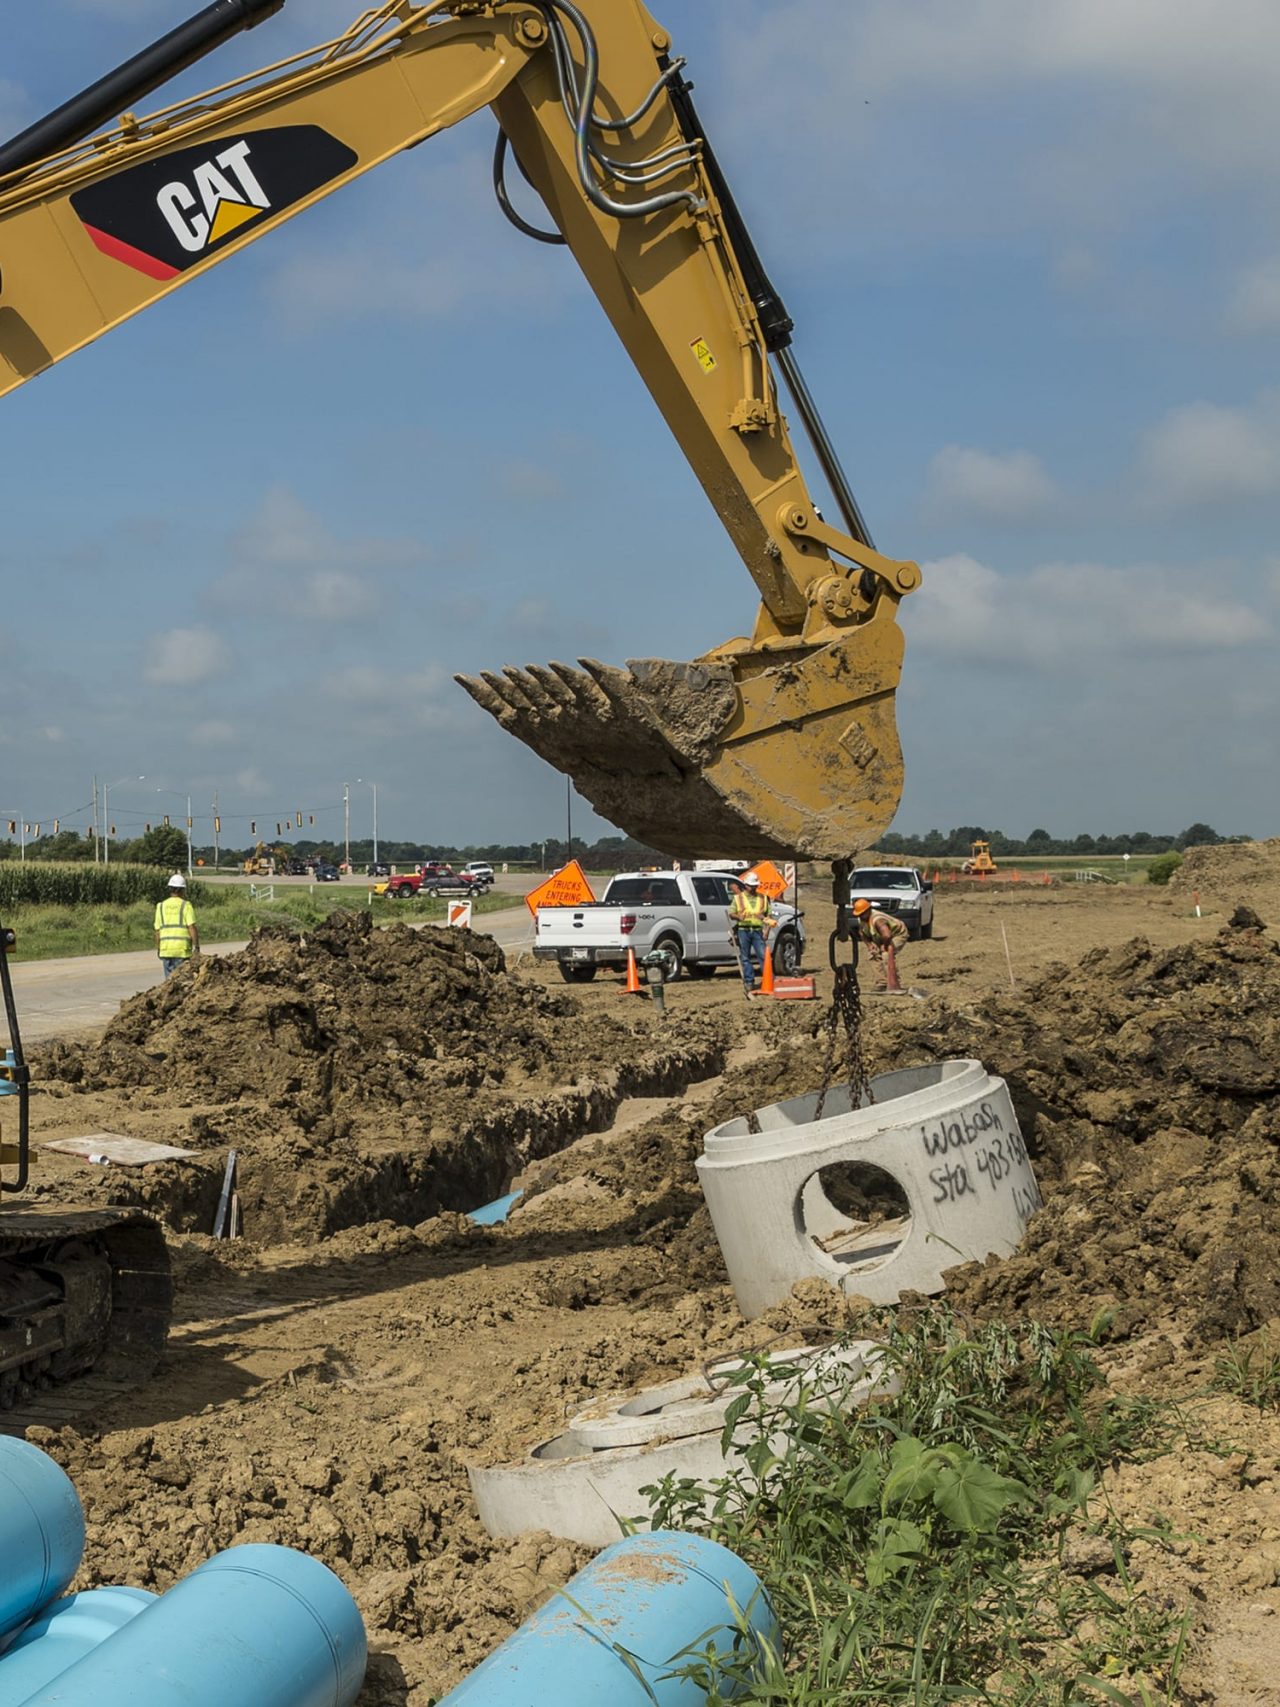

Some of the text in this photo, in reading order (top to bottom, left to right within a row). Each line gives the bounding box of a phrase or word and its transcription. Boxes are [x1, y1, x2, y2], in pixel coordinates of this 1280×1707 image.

[156, 140, 271, 252] CAT
[553, 880, 582, 891] TRUCKS
[546, 890, 581, 902] ENTERING
